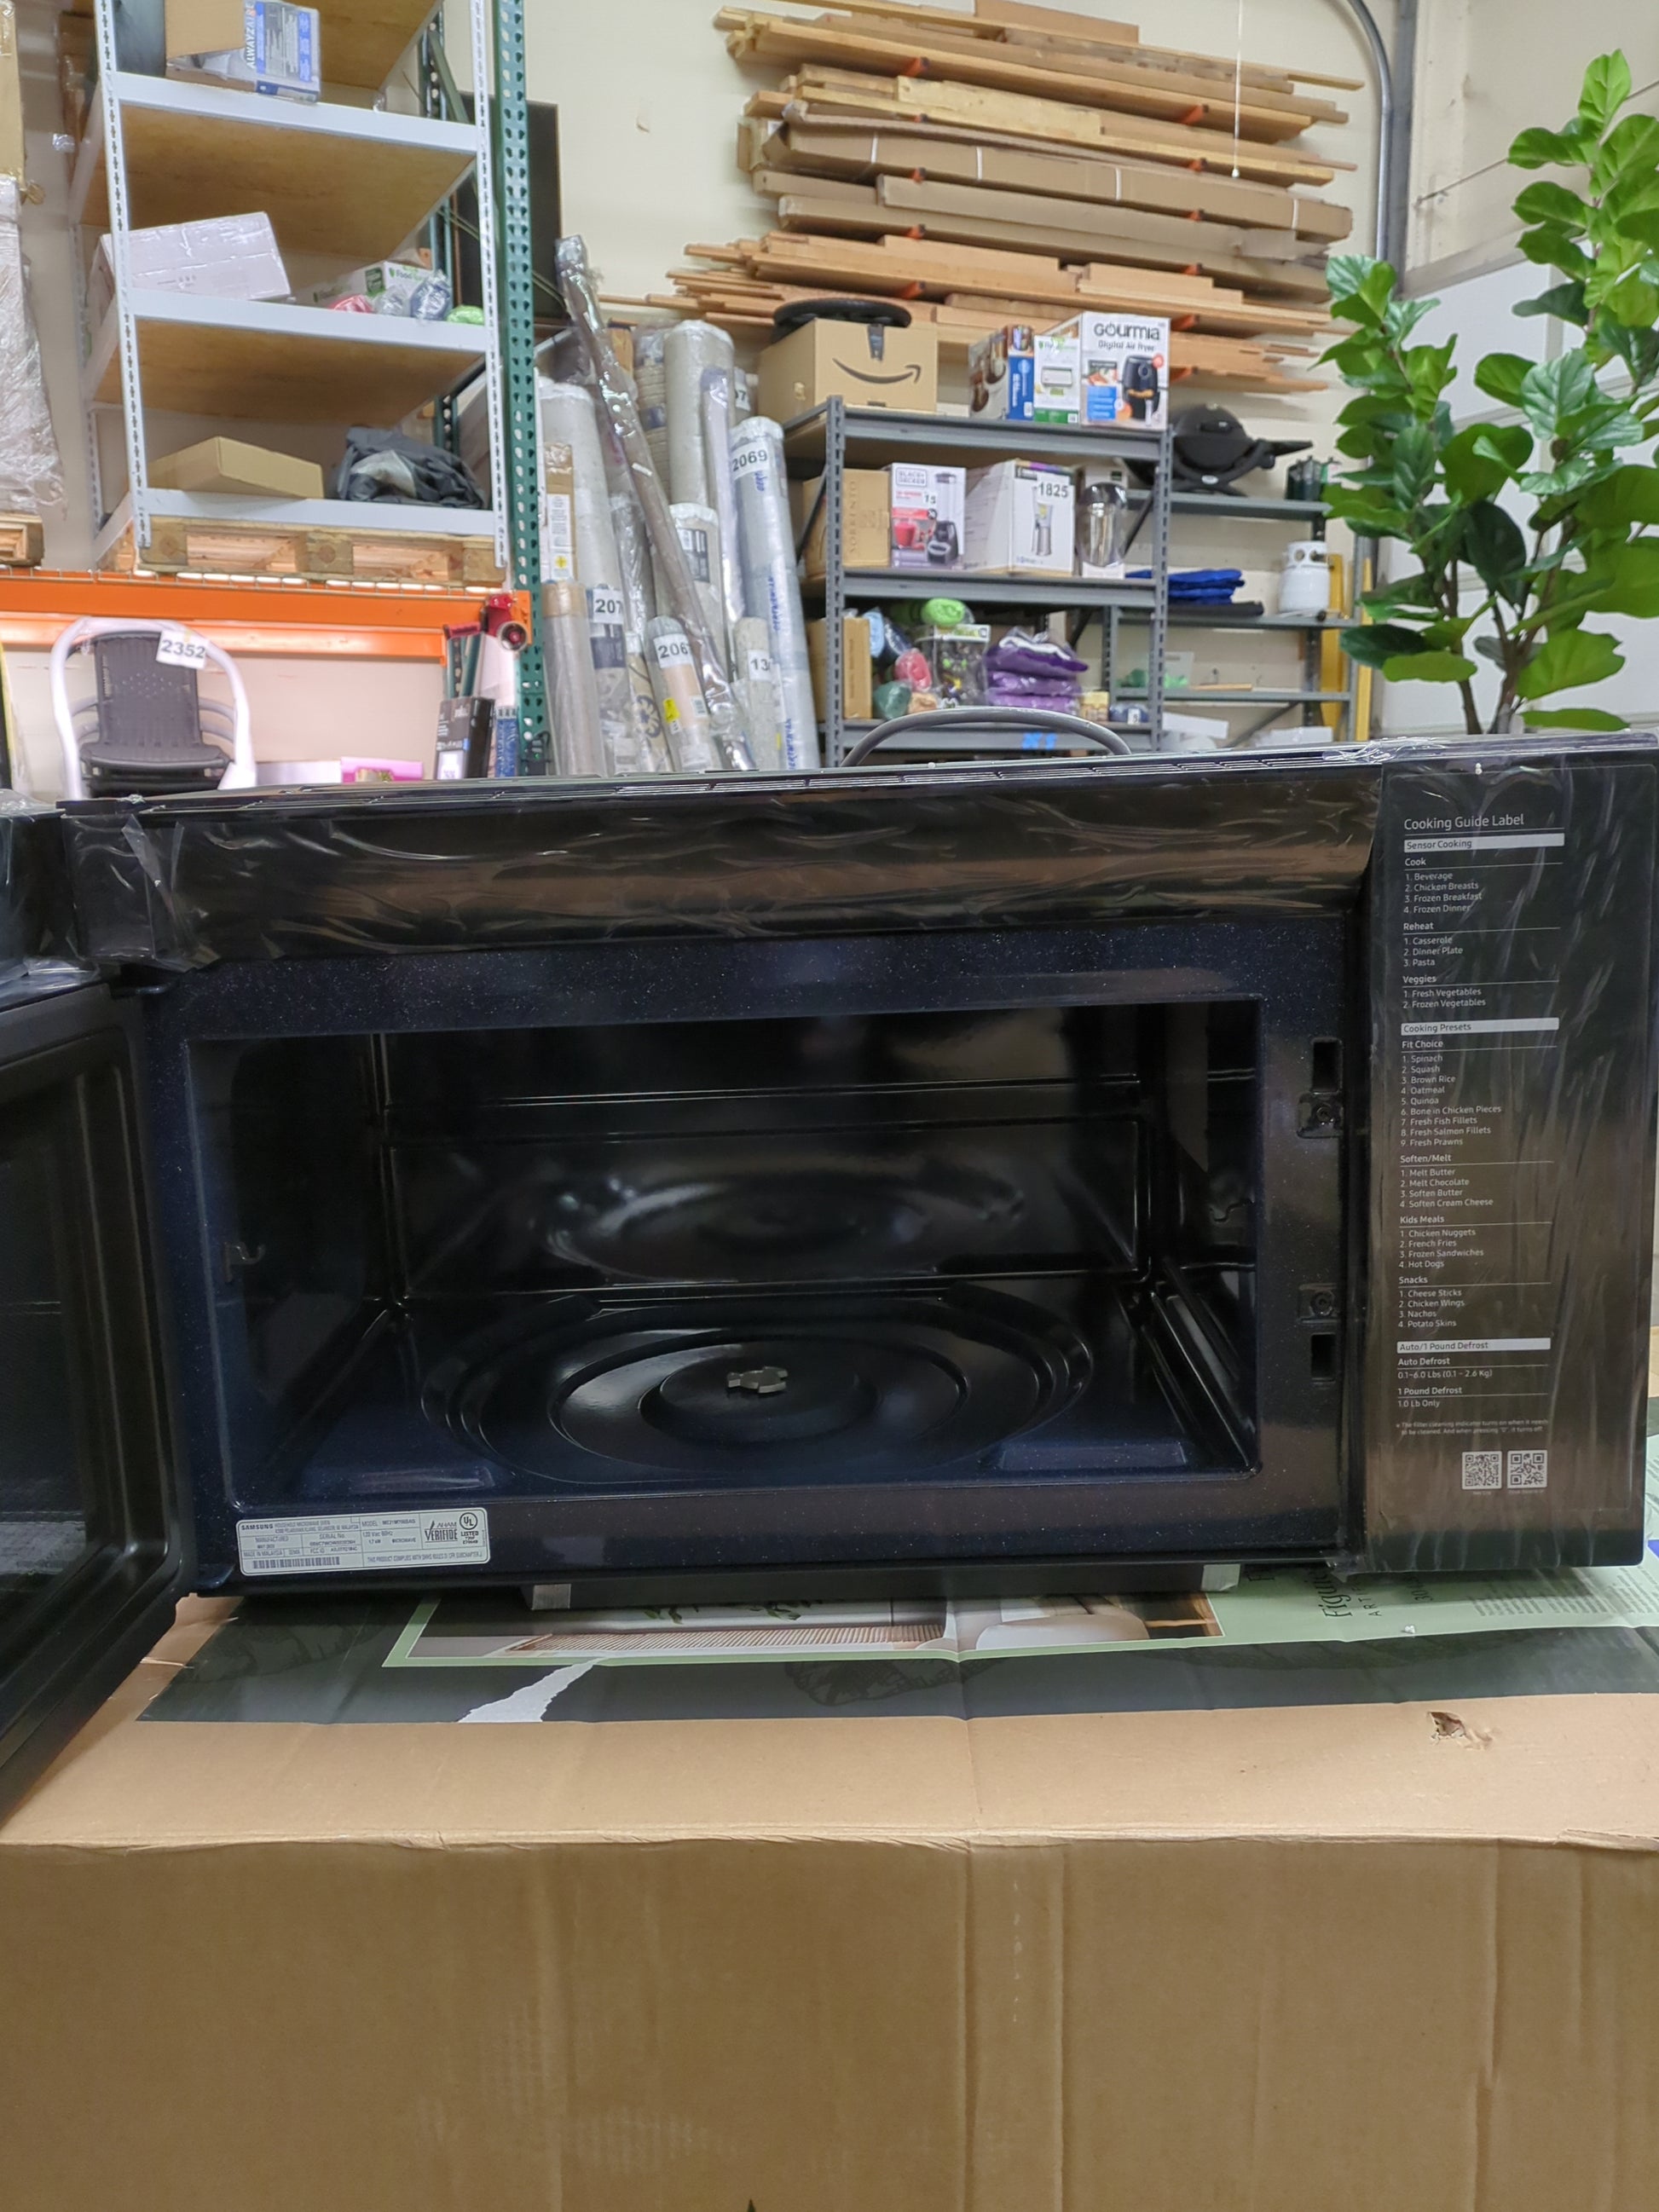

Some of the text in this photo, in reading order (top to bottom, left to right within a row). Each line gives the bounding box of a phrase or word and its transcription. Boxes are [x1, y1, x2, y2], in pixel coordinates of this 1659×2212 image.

[1098, 341, 1124, 350] Digital
[732, 450, 767, 472] 2069
[1038, 482, 1069, 499] 1825
[161, 639, 205, 659] 2352
[1404, 814, 1524, 830] Cooking Guide Label
[1407, 840, 1472, 850] Sensor Cooking
[1414, 872, 1453, 881] Beverage
[1442, 892, 1482, 901] Breakfast
[1413, 936, 1453, 944] Casserole
[1413, 958, 1435, 967] Pasta
[1403, 975, 1436, 984] Veggies
[1436, 988, 1482, 996] Vegetables
[1440, 999, 1486, 1008] Vegetables
[1440, 1023, 1471, 1031] Presets
[1411, 1054, 1442, 1064] Spinach
[1411, 1066, 1440, 1075] Squash
[1400, 1155, 1452, 1164] Soften/Melt
[1442, 1228, 1476, 1237] Nuggets
[1425, 1260, 1444, 1268] Dogs
[1440, 1299, 1465, 1308] Wings
[1400, 1343, 1428, 1351] Auto/1
[1479, 1369, 1492, 1377] Kg)
[1422, 1400, 1440, 1408] Only
